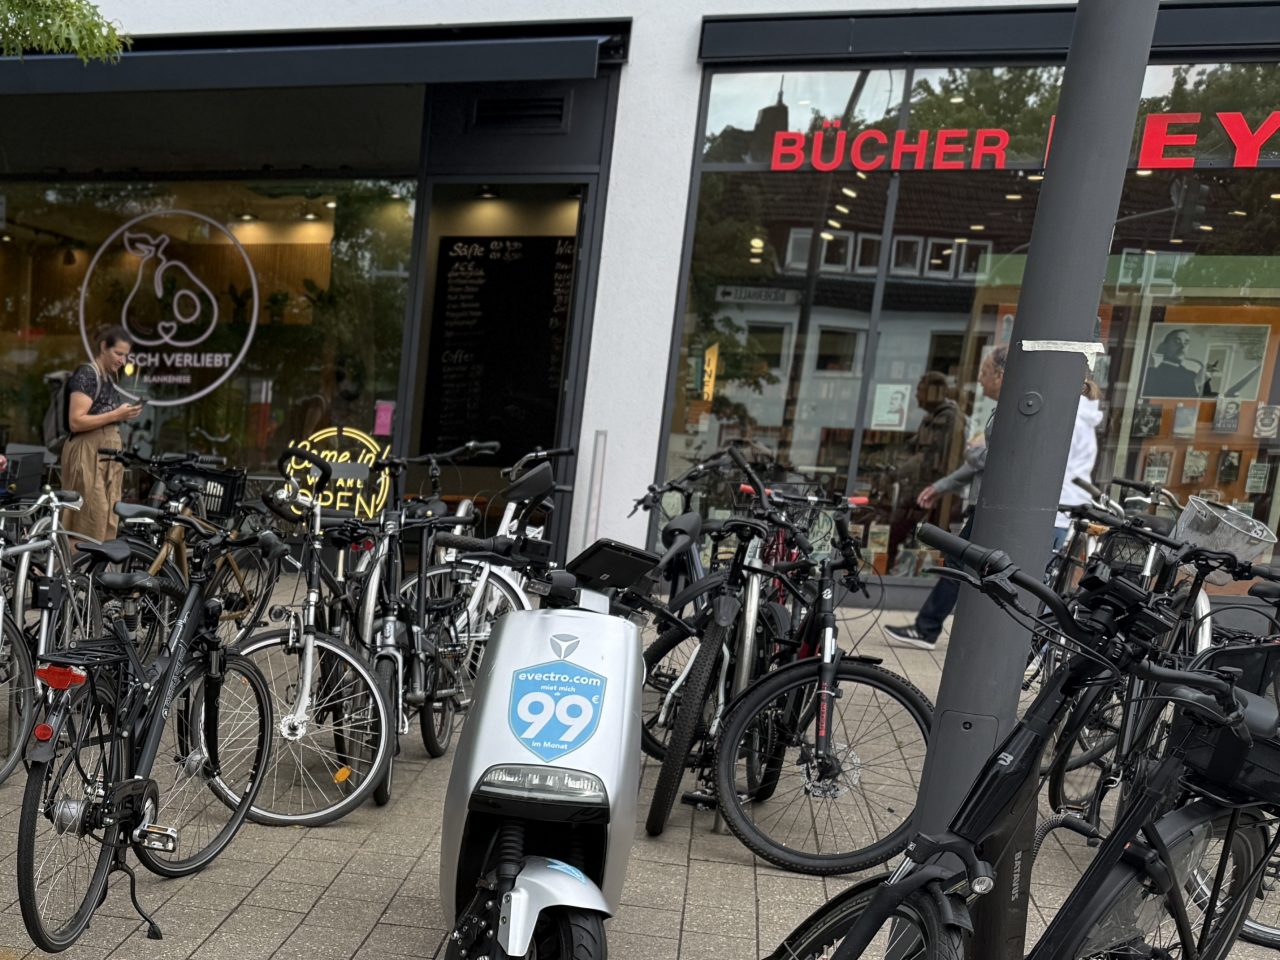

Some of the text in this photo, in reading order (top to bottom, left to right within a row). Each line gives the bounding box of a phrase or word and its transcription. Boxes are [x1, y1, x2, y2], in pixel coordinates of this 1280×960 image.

[770, 110, 1280, 172] BÜCHER EY
[163, 352, 233, 368] VERLIEBT
[518, 671, 601, 687] evectro.com
